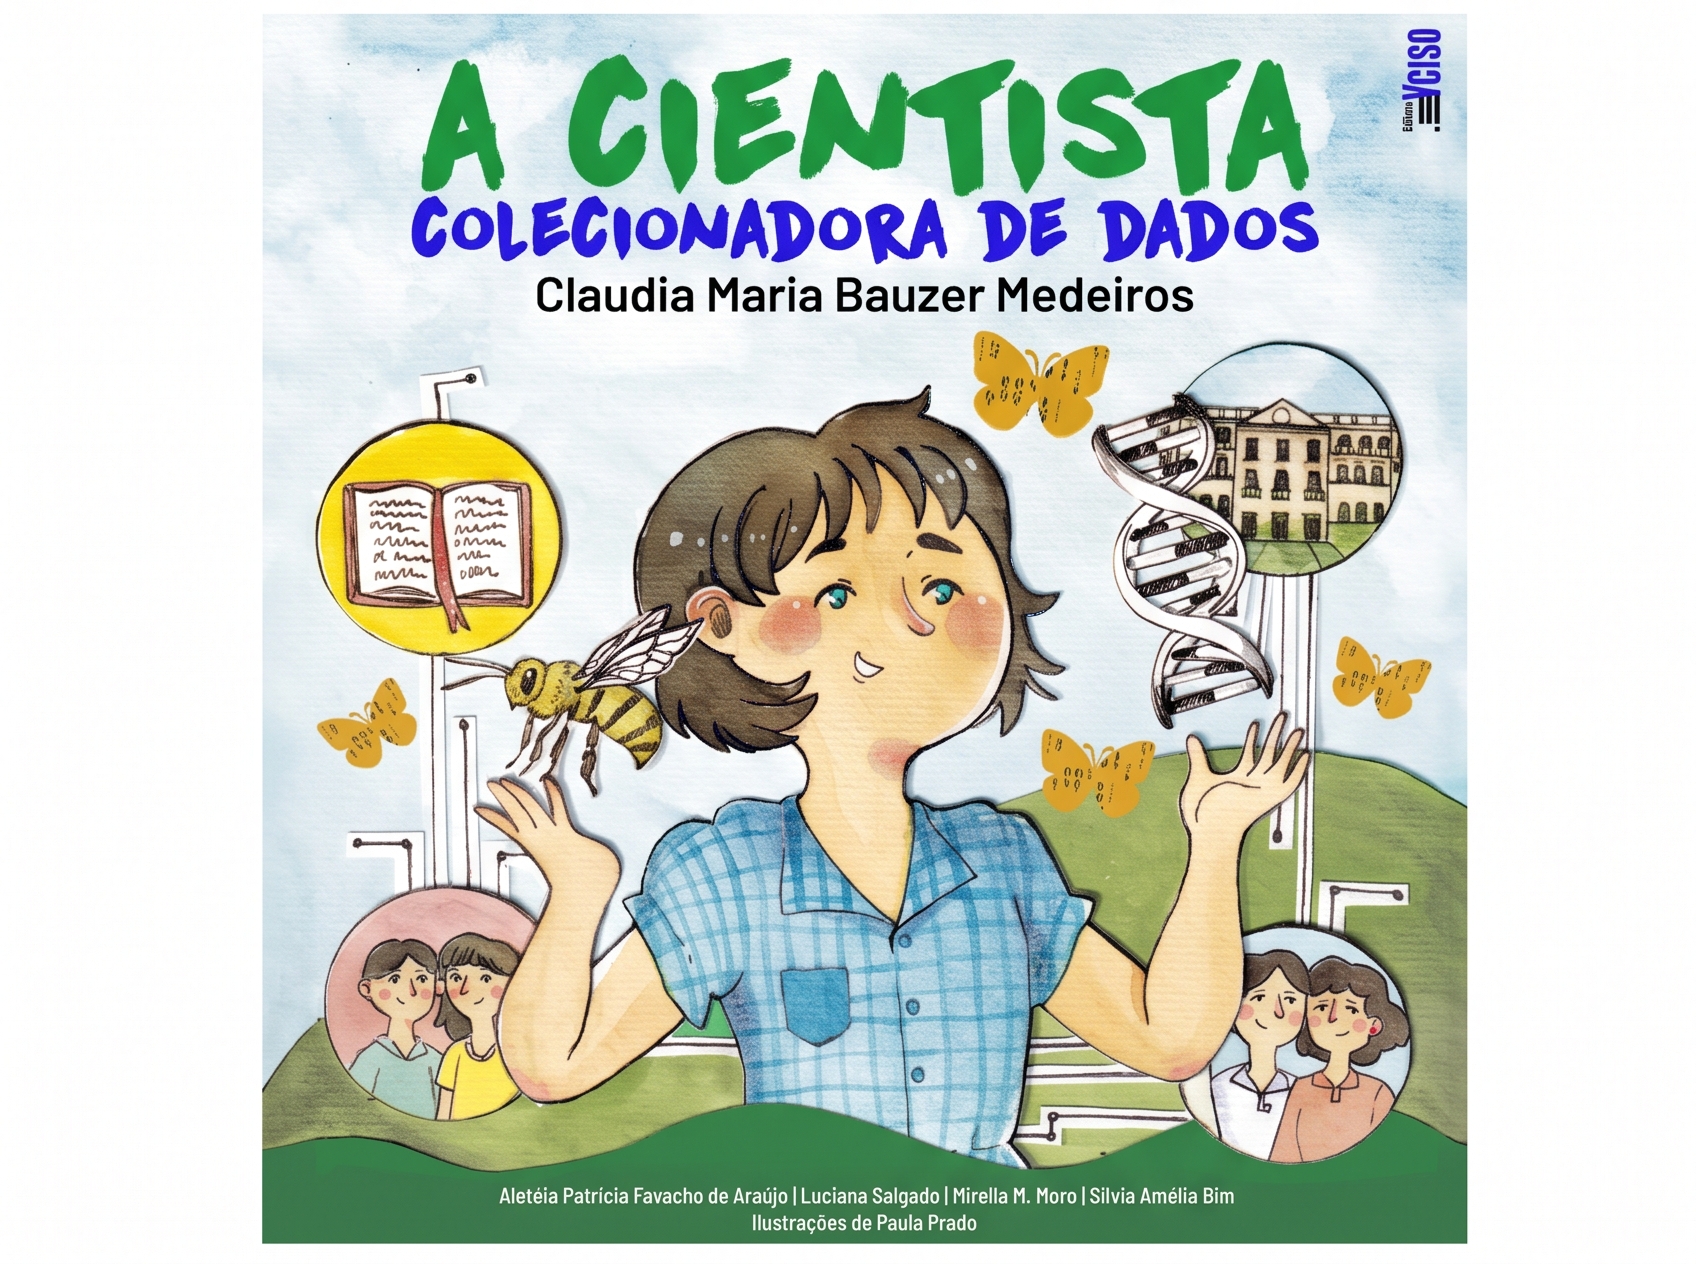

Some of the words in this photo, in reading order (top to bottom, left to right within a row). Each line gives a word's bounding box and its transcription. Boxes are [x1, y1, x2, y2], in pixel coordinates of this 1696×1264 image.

[421, 59, 505, 192] A
[567, 54, 1310, 197] CIENTISTA
[411, 195, 948, 265] COLECIONADORA
[977, 197, 1067, 263] DE
[1097, 198, 1320, 263] DADOS
[536, 276, 694, 313] Claudia
[709, 276, 823, 313] Maria
[837, 277, 986, 313] Bauzer
[998, 276, 1195, 313] Medeiros
[499, 1186, 558, 1204] Aletéia
[563, 1186, 629, 1204] Patrícia
[634, 1187, 703, 1204] Favacho
[708, 1187, 729, 1204] de
[733, 1187, 788, 1209] Araújo
[801, 1187, 868, 1204] Luciana
[872, 1187, 940, 1209] Salgado
[953, 1187, 1008, 1204] Mirella
[1013, 1187, 1031, 1204] M.
[1036, 1187, 1077, 1204] Moro
[1089, 1187, 1135, 1204] Silvia
[1140, 1186, 1198, 1204] Amélia
[1203, 1187, 1235, 1204] Bim
[752, 1214, 847, 1235] Ilustrações
[851, 1214, 872, 1231] de
[877, 1214, 923, 1231] Paula
[928, 1214, 977, 1231] Prado
